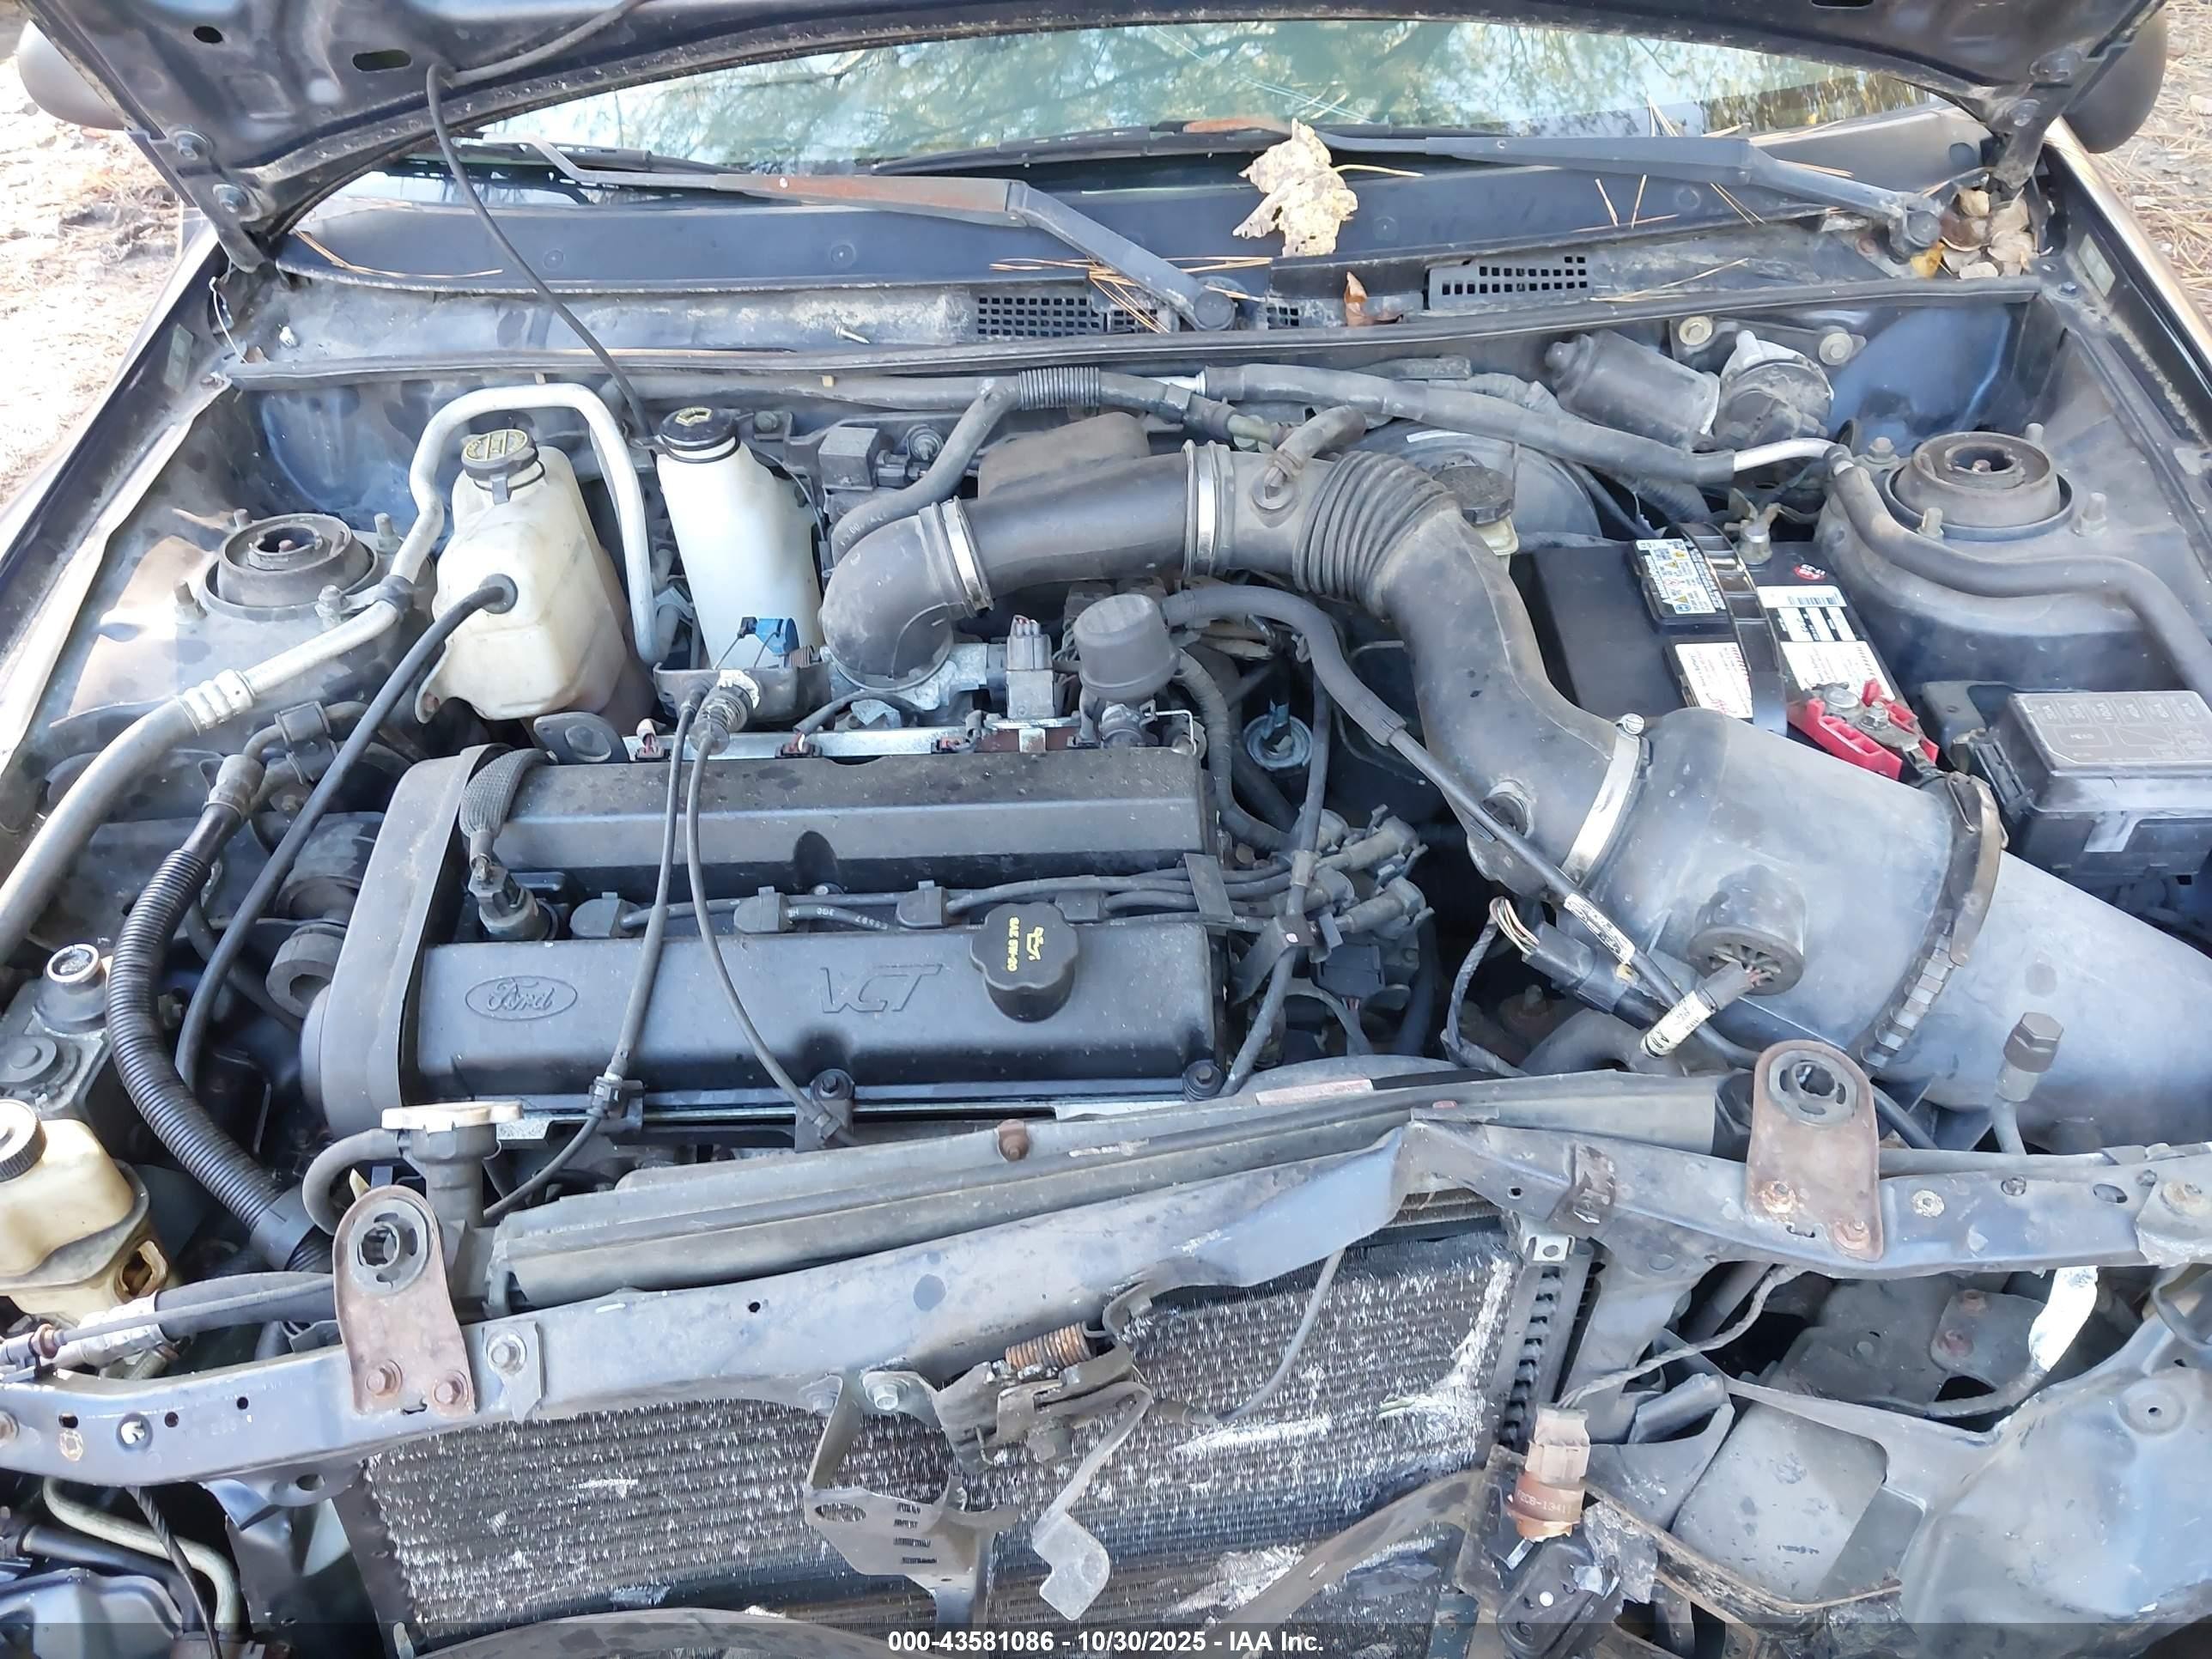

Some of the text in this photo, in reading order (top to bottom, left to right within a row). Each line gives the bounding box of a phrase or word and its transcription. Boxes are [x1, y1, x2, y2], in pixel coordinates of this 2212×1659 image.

[2096, 702, 2115, 720] 100A
[1006, 916, 1020, 972] SAE 5W-20
[487, 977, 555, 1012] Ford
[818, 963, 944, 1014] VCT
